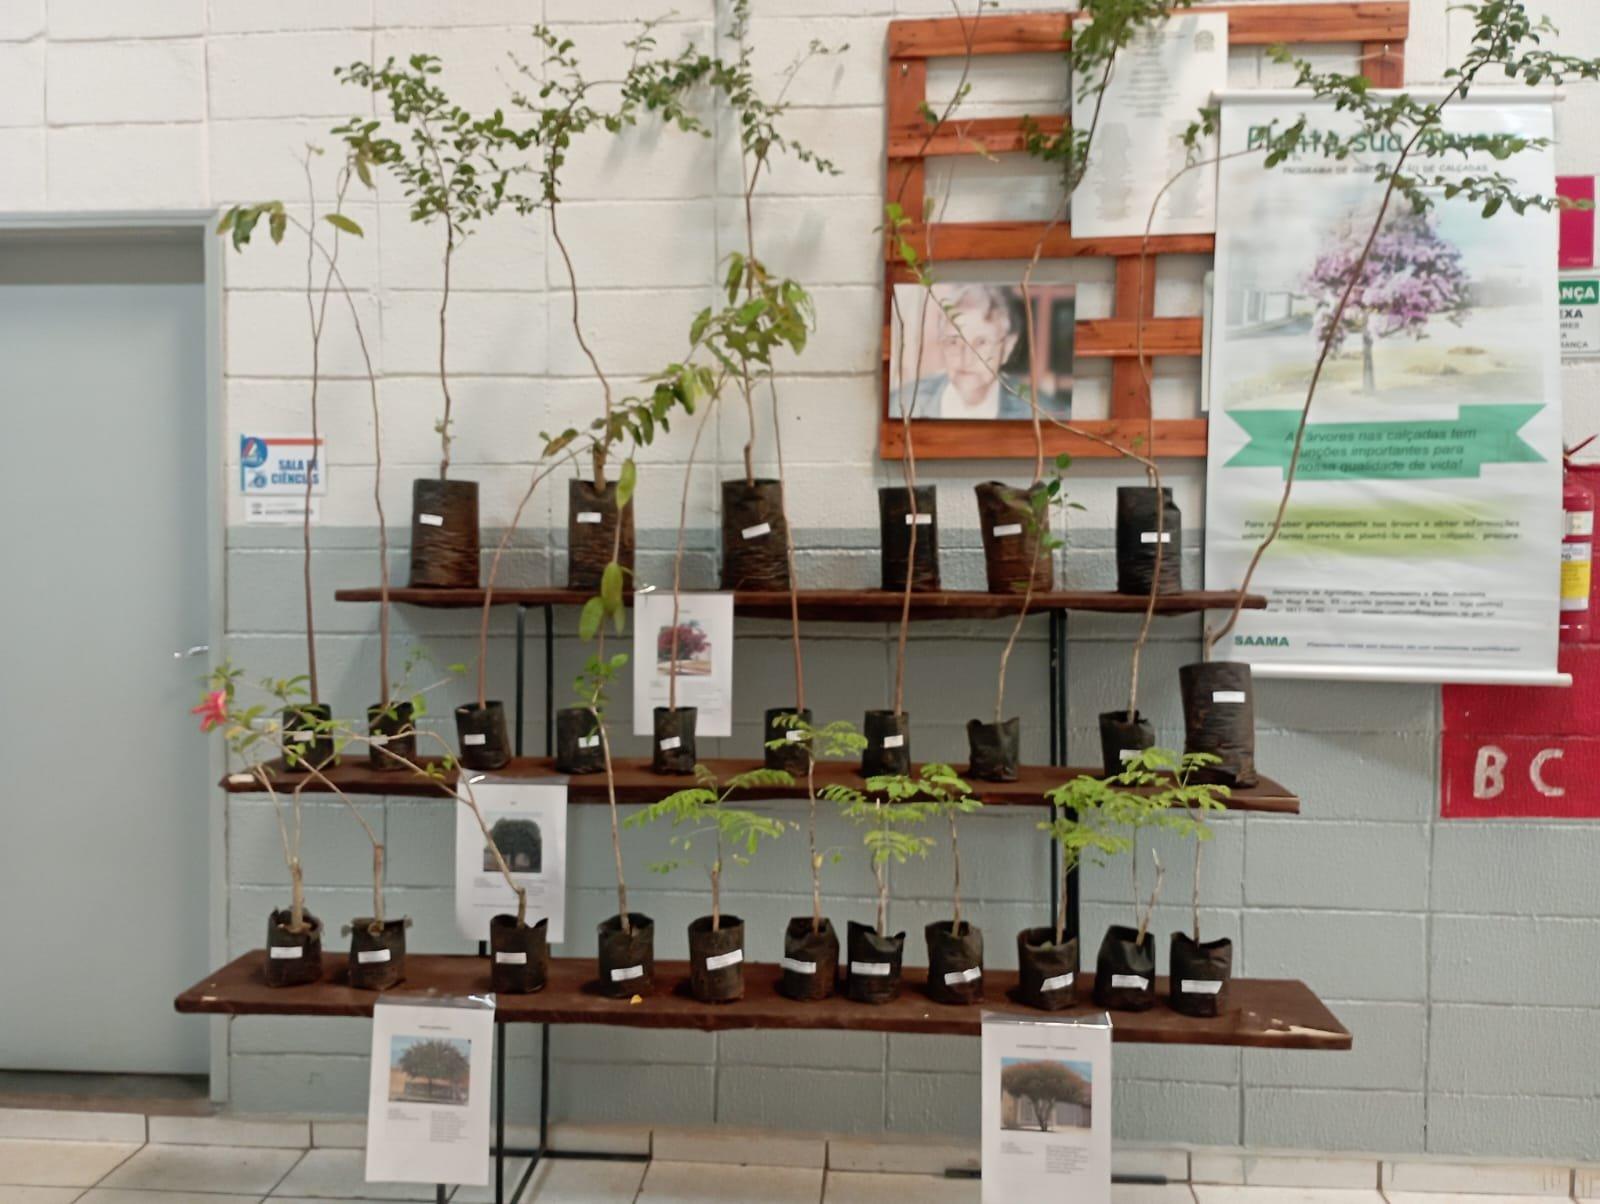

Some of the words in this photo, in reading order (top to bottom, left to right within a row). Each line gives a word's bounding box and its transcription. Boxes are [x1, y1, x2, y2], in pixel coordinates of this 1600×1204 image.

[1353, 132, 1403, 152] sua
[1306, 429, 1354, 442] árvores
[1358, 431, 1383, 442] nas
[1386, 428, 1447, 444] calçadas
[1298, 445, 1347, 460] unções
[1350, 444, 1430, 459] importantes
[1432, 444, 1464, 457] para
[278, 459, 304, 470] SALA
[1340, 459, 1407, 474] qualidade
[1409, 458, 1426, 471] de
[1429, 458, 1463, 471] vida!
[271, 472, 319, 484] CIÊNCIS
[1235, 635, 1290, 647] SAAMA
[1473, 744, 1509, 799] B
[1529, 748, 1565, 797] C
